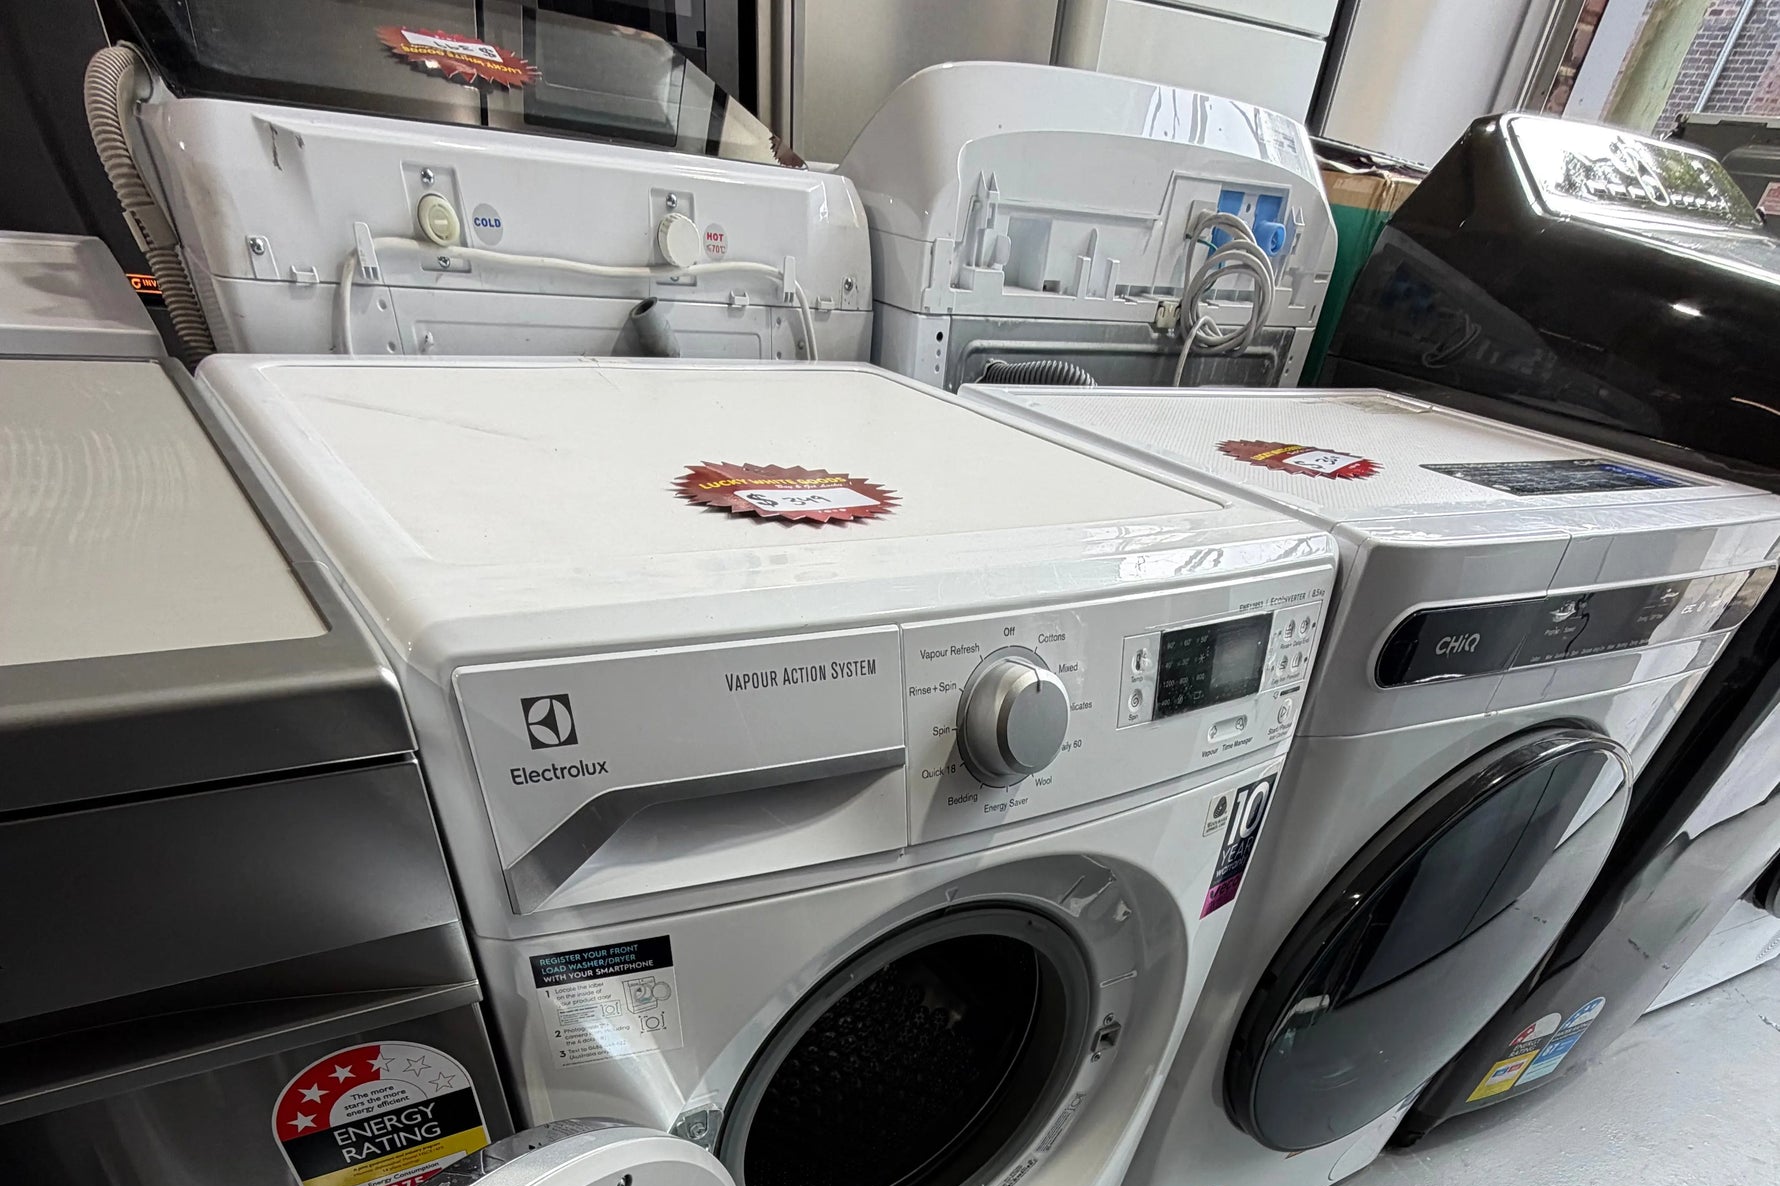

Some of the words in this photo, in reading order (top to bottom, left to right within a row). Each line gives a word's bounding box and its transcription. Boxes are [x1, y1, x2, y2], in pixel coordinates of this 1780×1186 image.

[474, 217, 501, 228] COLD
[706, 232, 724, 242] HOT
[699, 478, 747, 490] LUCKY
[749, 478, 797, 486] WHITE
[797, 477, 847, 485] GOODS
[746, 493, 779, 508] $
[1003, 627, 1016, 637] Off
[1038, 632, 1066, 644] Cottons
[920, 650, 949, 661] Vapour
[950, 643, 980, 657] Refresh
[725, 670, 779, 693] VAPOUR
[782, 664, 827, 687] ACTION
[830, 658, 877, 682] SYSTEM
[1058, 662, 1079, 674] Mixed
[909, 682, 957, 697] Rinse+Spin
[1070, 701, 1093, 713] licates
[932, 725, 950, 737] Spin
[1072, 740, 1082, 749] 60
[1222, 743, 1234, 751] Time
[1234, 737, 1254, 747] Manager
[510, 758, 609, 786] Electrolux
[921, 768, 944, 780] Quick
[946, 765, 956, 774] 18
[1035, 776, 1053, 787] Wool
[947, 793, 978, 806] Bedding
[984, 801, 1007, 813] Energy
[1009, 797, 1029, 808] Saver
[1227, 781, 1270, 846] 10
[1222, 836, 1253, 866] YEAR
[539, 954, 581, 966] REGISTER
[582, 949, 608, 960] YOUR
[610, 944, 639, 955] FRONT
[541, 965, 567, 975] LOAD
[568, 954, 636, 970] WASHER/DRYER
[543, 974, 567, 983] WITH
[568, 970, 593, 979] YOUR
[595, 960, 654, 976] SMARTPHONE
[545, 990, 550, 998] 1
[554, 1030, 562, 1038] 2
[344, 1101, 365, 1110] stars
[383, 1089, 406, 1099] more
[351, 1092, 369, 1100] The
[370, 1085, 394, 1096] more
[346, 1106, 374, 1117] energy
[377, 1096, 410, 1108] efficient
[333, 1102, 436, 1146] ENERGY
[342, 1122, 442, 1163] RATING
[394, 1162, 440, 1180] Consumption
